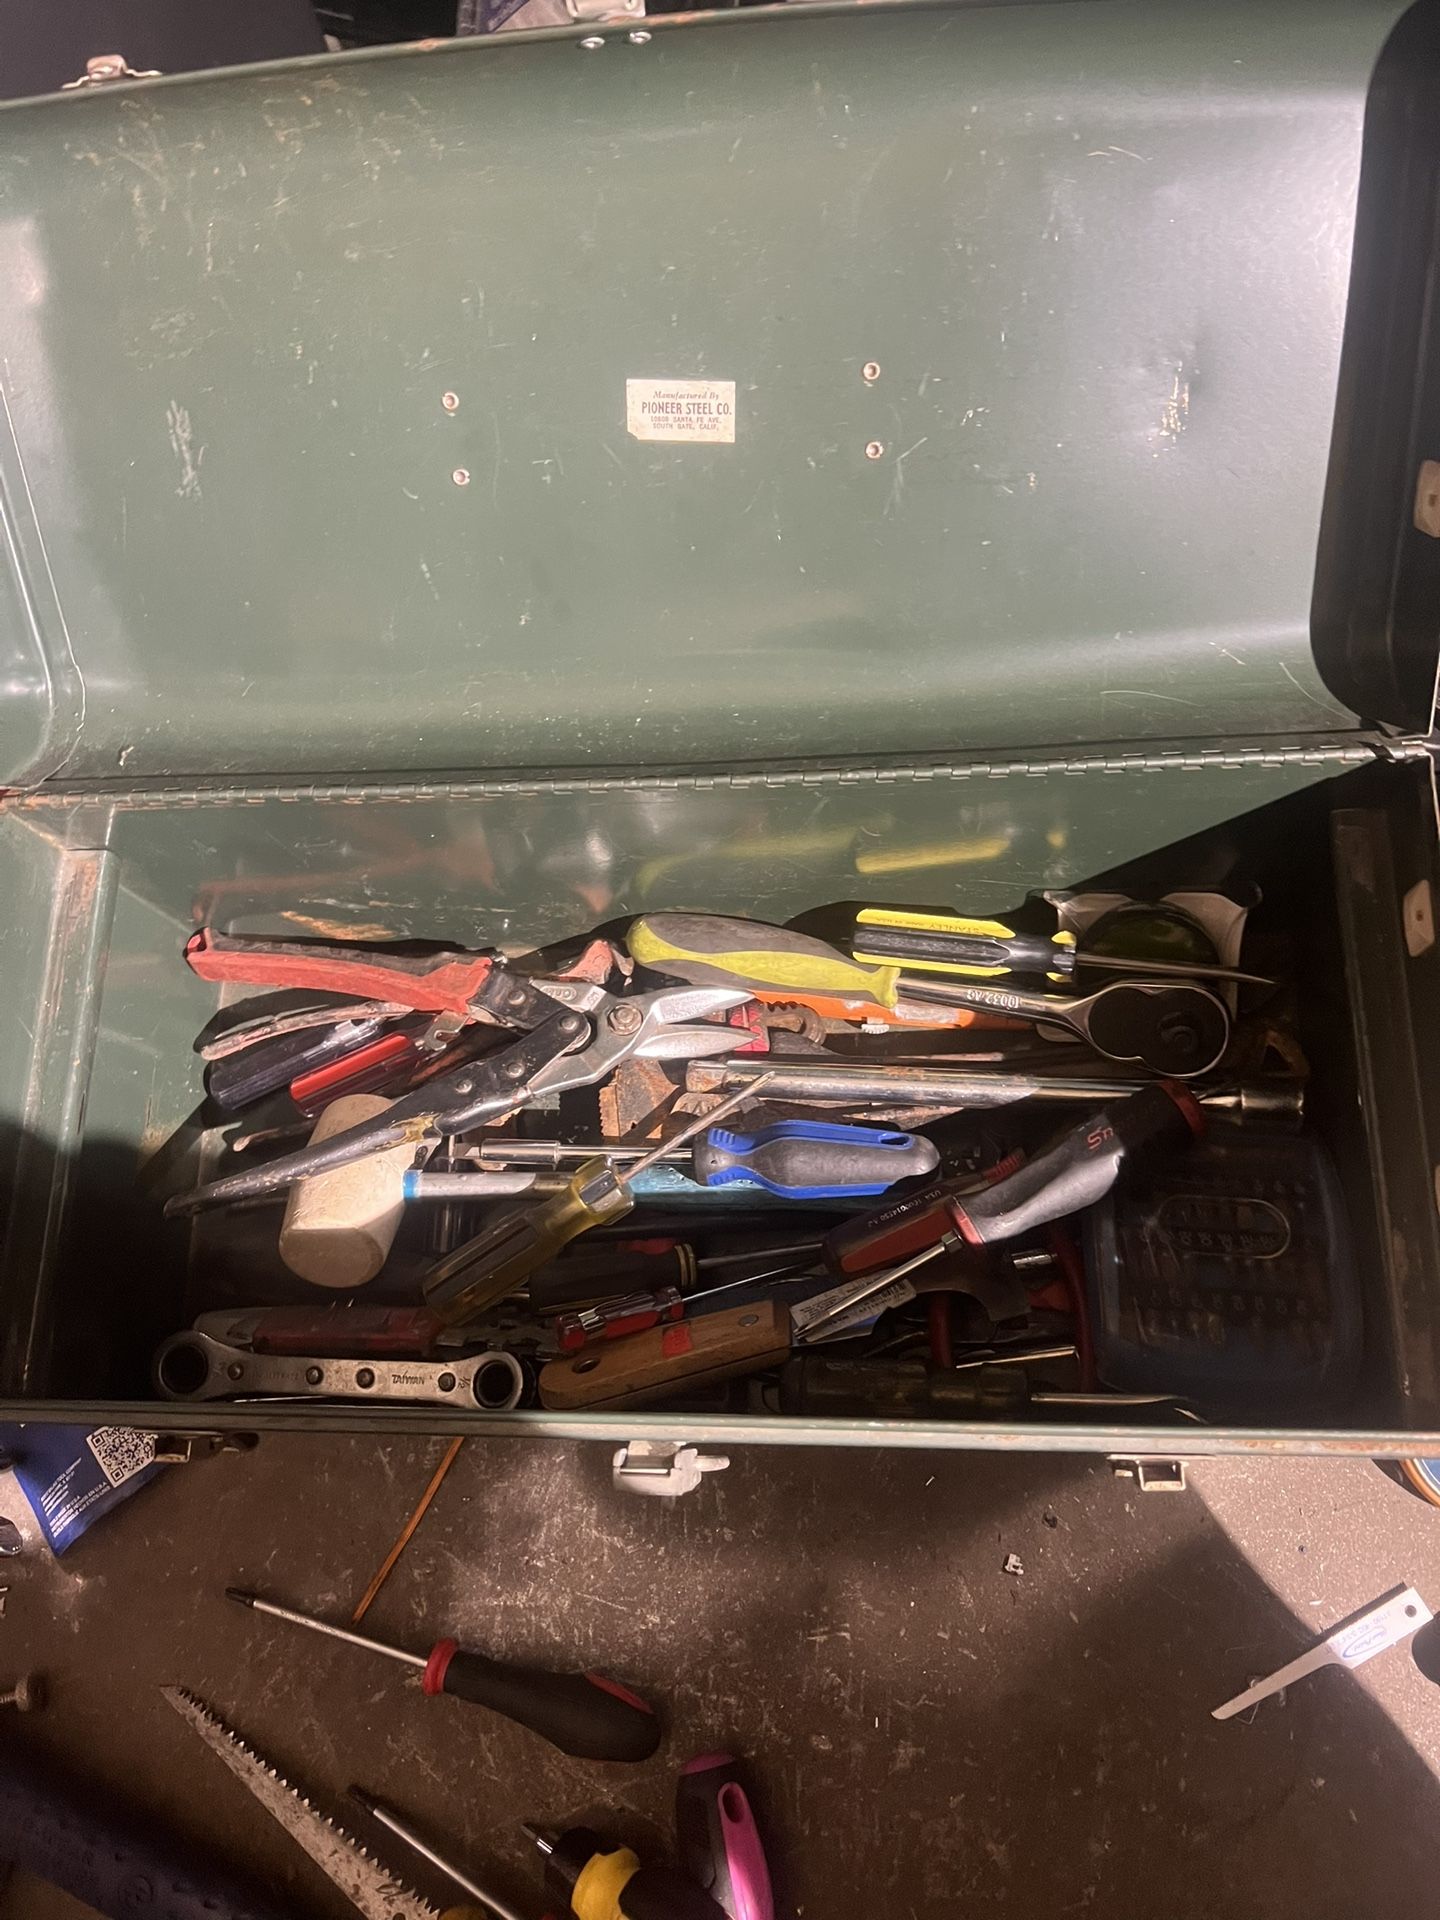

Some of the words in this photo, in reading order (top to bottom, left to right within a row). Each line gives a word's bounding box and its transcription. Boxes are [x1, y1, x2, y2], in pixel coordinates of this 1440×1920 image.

[652, 391, 707, 400] Manufactured
[709, 391, 719, 400] By
[641, 402, 682, 414] PIONEER
[685, 402, 713, 415] STEEL
[716, 403, 732, 415] CO.
[929, 922, 980, 934] STANLEY
[391, 1373, 425, 1385] TAIWAN
